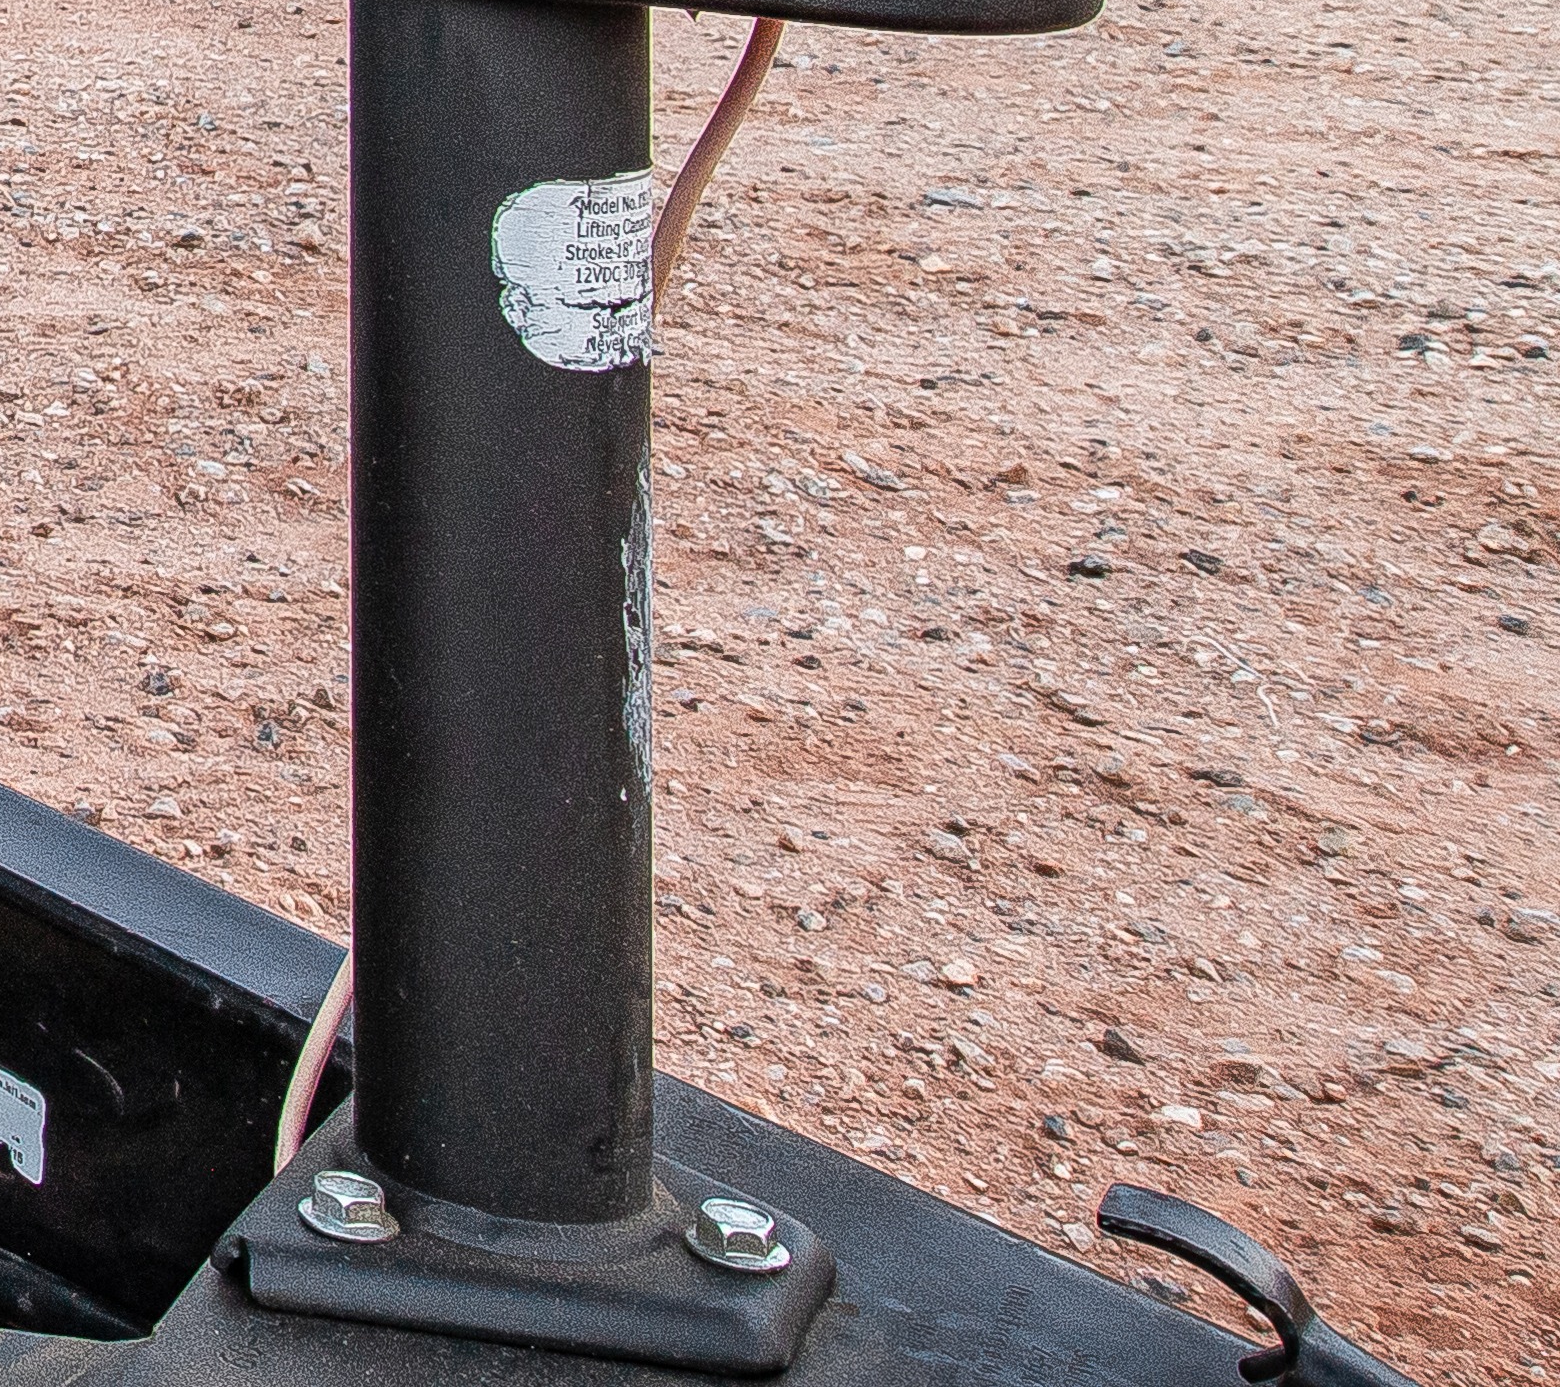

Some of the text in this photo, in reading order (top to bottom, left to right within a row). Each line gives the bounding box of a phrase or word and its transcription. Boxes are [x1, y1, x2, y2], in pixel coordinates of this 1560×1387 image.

[580, 196, 619, 215] Model
[577, 221, 620, 240] Lifting
[565, 243, 614, 261] Stroke
[576, 266, 620, 284] 12VDC
